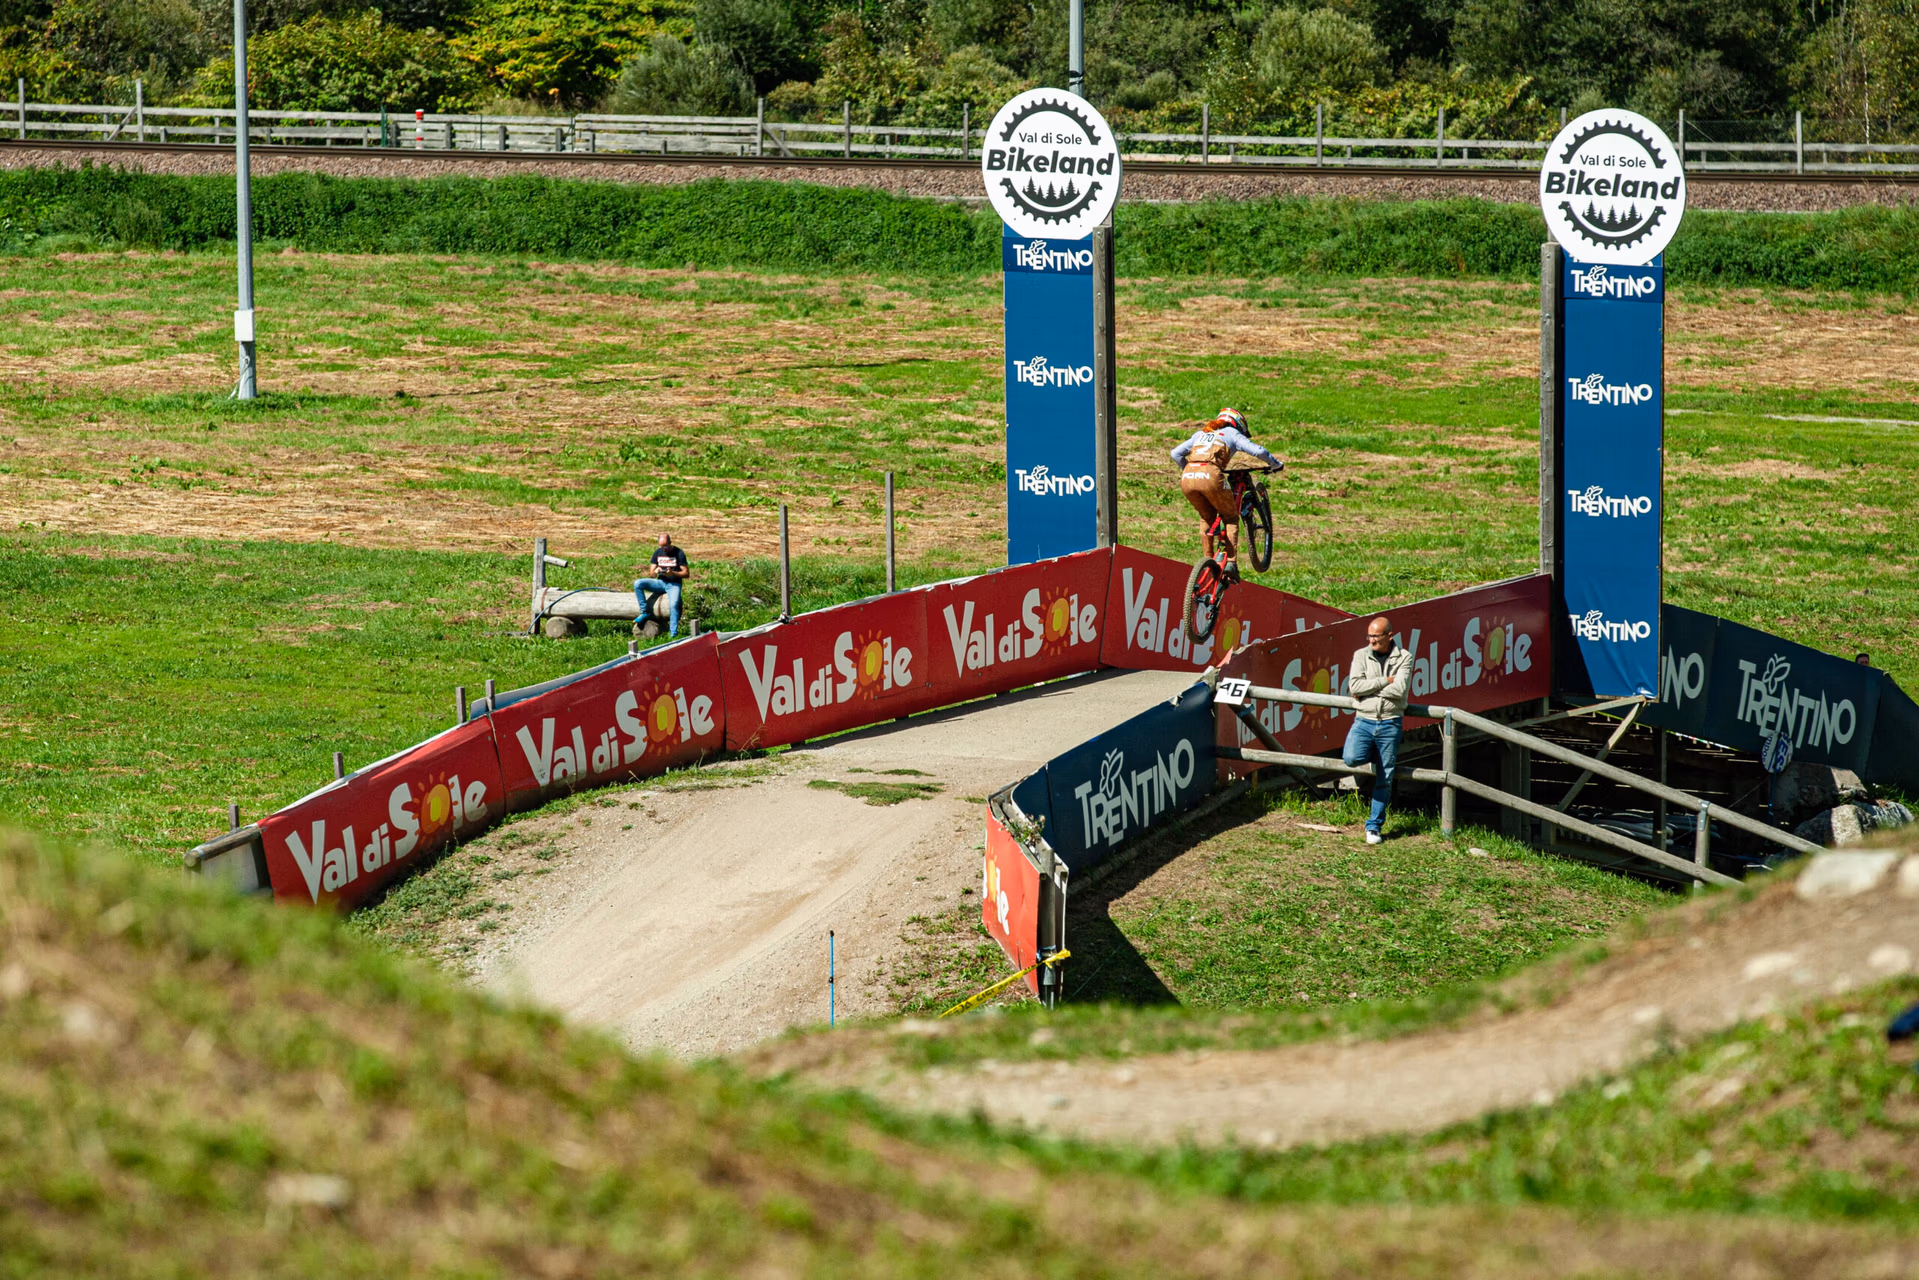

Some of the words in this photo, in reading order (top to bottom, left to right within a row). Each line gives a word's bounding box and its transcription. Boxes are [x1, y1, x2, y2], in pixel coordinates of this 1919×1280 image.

[1019, 132, 1038, 144] Val
[1041, 133, 1053, 144] di
[1056, 134, 1082, 145] Sole
[986, 146, 1115, 176] Bikeland
[1580, 154, 1600, 166] Val
[1604, 155, 1615, 166] di
[1619, 156, 1646, 168] Sole
[1545, 170, 1680, 200] Bikeland
[1012, 242, 1092, 271] TRENTINO
[1571, 268, 1656, 298] TRENTINO
[1014, 358, 1094, 387] TRENTINO
[1568, 376, 1652, 406] TRENTINO
[1015, 468, 1094, 496] TRENTINO
[1568, 488, 1652, 518] TRENTINO
[1122, 568, 1169, 650] Val
[943, 600, 994, 679] Val
[999, 620, 1020, 662] di
[1022, 588, 1098, 658] Sole
[1568, 612, 1650, 642] TRENTINO
[1441, 648, 1462, 690] di
[1464, 616, 1532, 686] Sole
[738, 644, 804, 724] Val
[809, 665, 832, 708] di
[834, 631, 912, 704] Sole
[1738, 656, 1856, 754] TRENTINO
[516, 718, 587, 786] Val
[592, 726, 619, 774] di
[615, 687, 714, 764] Sole
[1074, 738, 1194, 849] TRENTINO
[285, 820, 358, 904] Val
[362, 822, 390, 873] di
[388, 774, 488, 860] Sole
